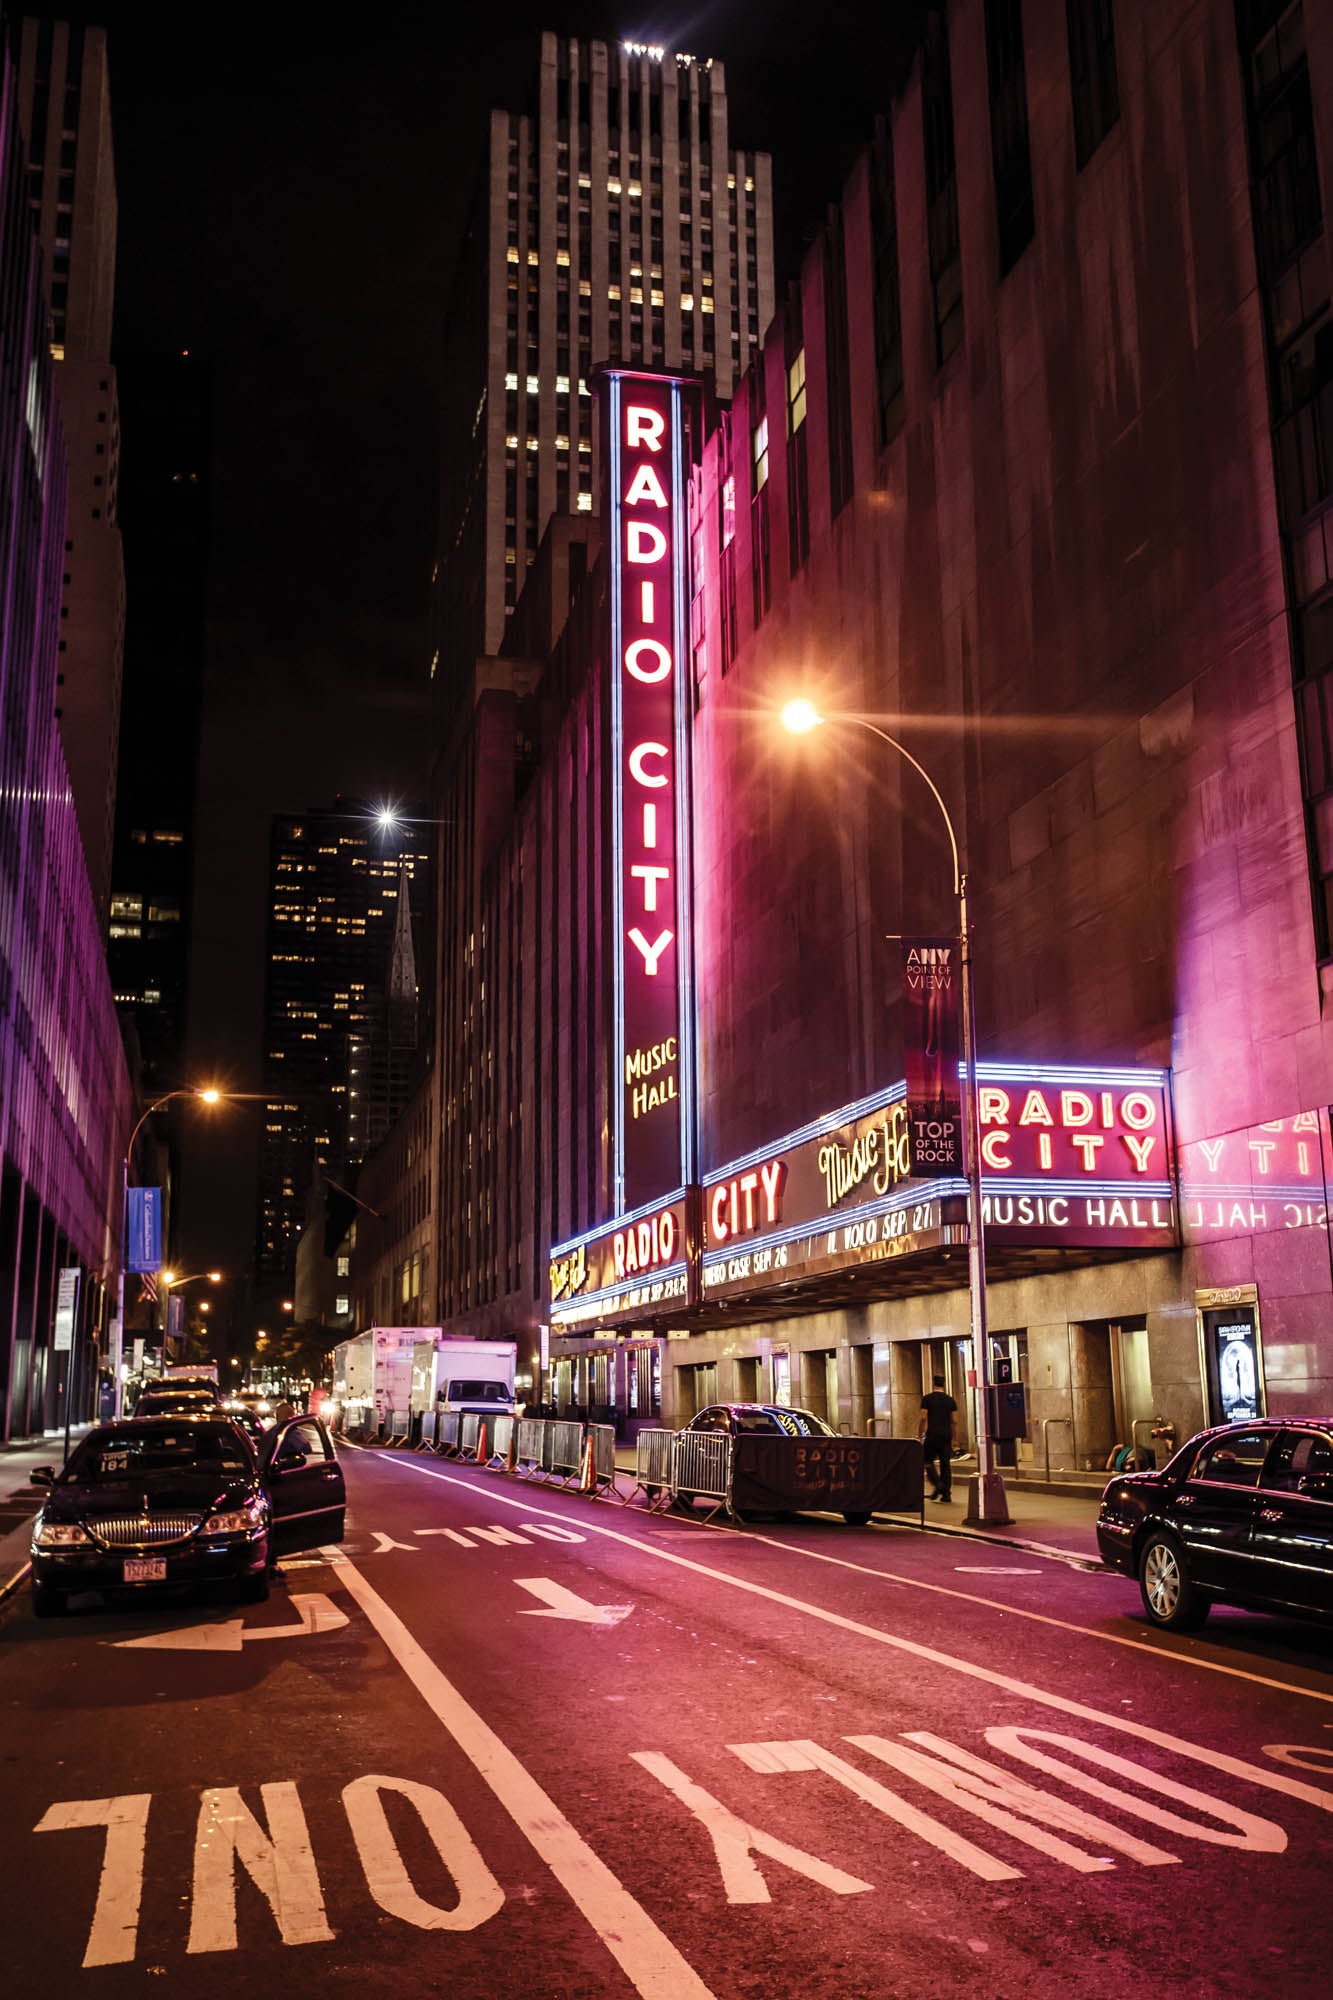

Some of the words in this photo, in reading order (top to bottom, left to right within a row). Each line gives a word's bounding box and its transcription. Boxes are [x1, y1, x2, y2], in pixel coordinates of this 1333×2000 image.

[625, 406, 672, 683] RADIO
[628, 742, 674, 976] CITY
[907, 948, 951, 965] ANY
[907, 966, 936, 975] POINT
[938, 966, 951, 975] OF
[907, 976, 951, 990] VIEW
[979, 1087, 1157, 1131] RADIO
[914, 1121, 954, 1138] TOP
[916, 1140, 930, 1149] OF
[932, 1140, 955, 1150] THE
[916, 1150, 955, 1162] ROCK
[981, 1130, 1156, 1172] CITY
[613, 1211, 674, 1278] RADIO
[711, 1161, 782, 1240] CITY
[818, 1130, 878, 1208] Music
[874, 1106, 910, 1195] Ha
[967, 1196, 1069, 1226] MUSIC
[1086, 1199, 1168, 1227] HALL
[827, 1231, 838, 1254] IL
[844, 1219, 877, 1249] VOLO
[882, 1211, 906, 1240] SEP
[913, 1202, 932, 1231] 27
[1001, 1364, 1009, 1377] P
[796, 1449, 860, 1463] RADIO
[796, 1464, 857, 1478] CITY
[370, 1523, 587, 1553] ONLY
[628, 1726, 1288, 1904] ONLY
